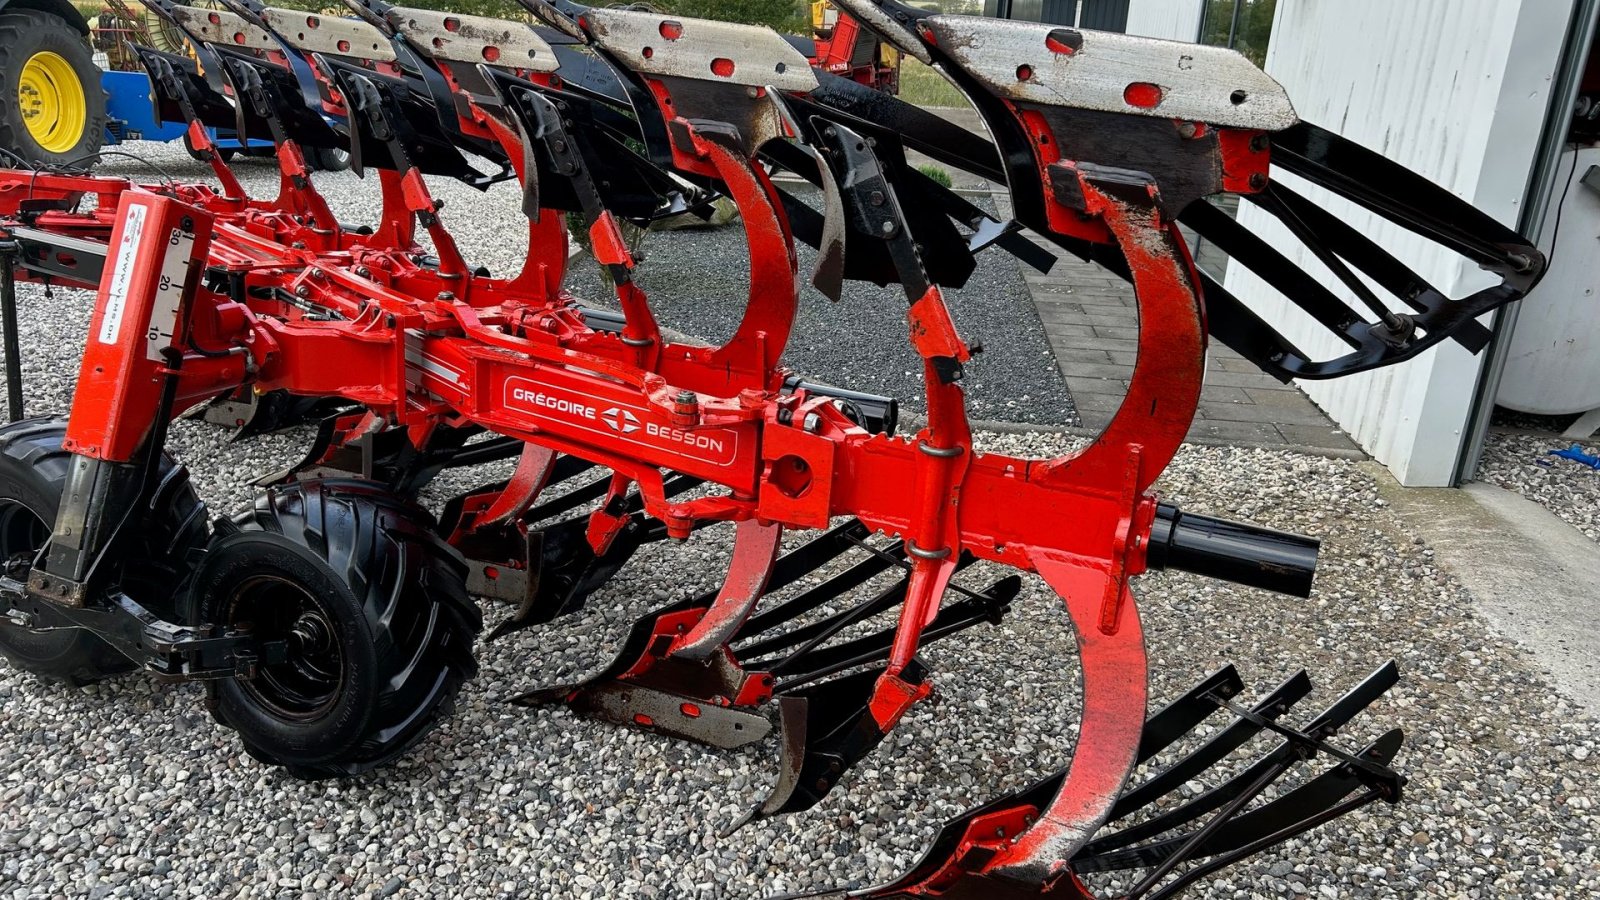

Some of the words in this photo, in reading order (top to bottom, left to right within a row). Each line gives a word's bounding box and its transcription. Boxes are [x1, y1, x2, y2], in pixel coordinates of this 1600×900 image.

[170, 229, 181, 246] 30
[159, 275, 171, 291] 20
[148, 326, 160, 342] 10
[513, 388, 597, 420] GRÉGOIRE
[646, 424, 723, 453] BESSON
